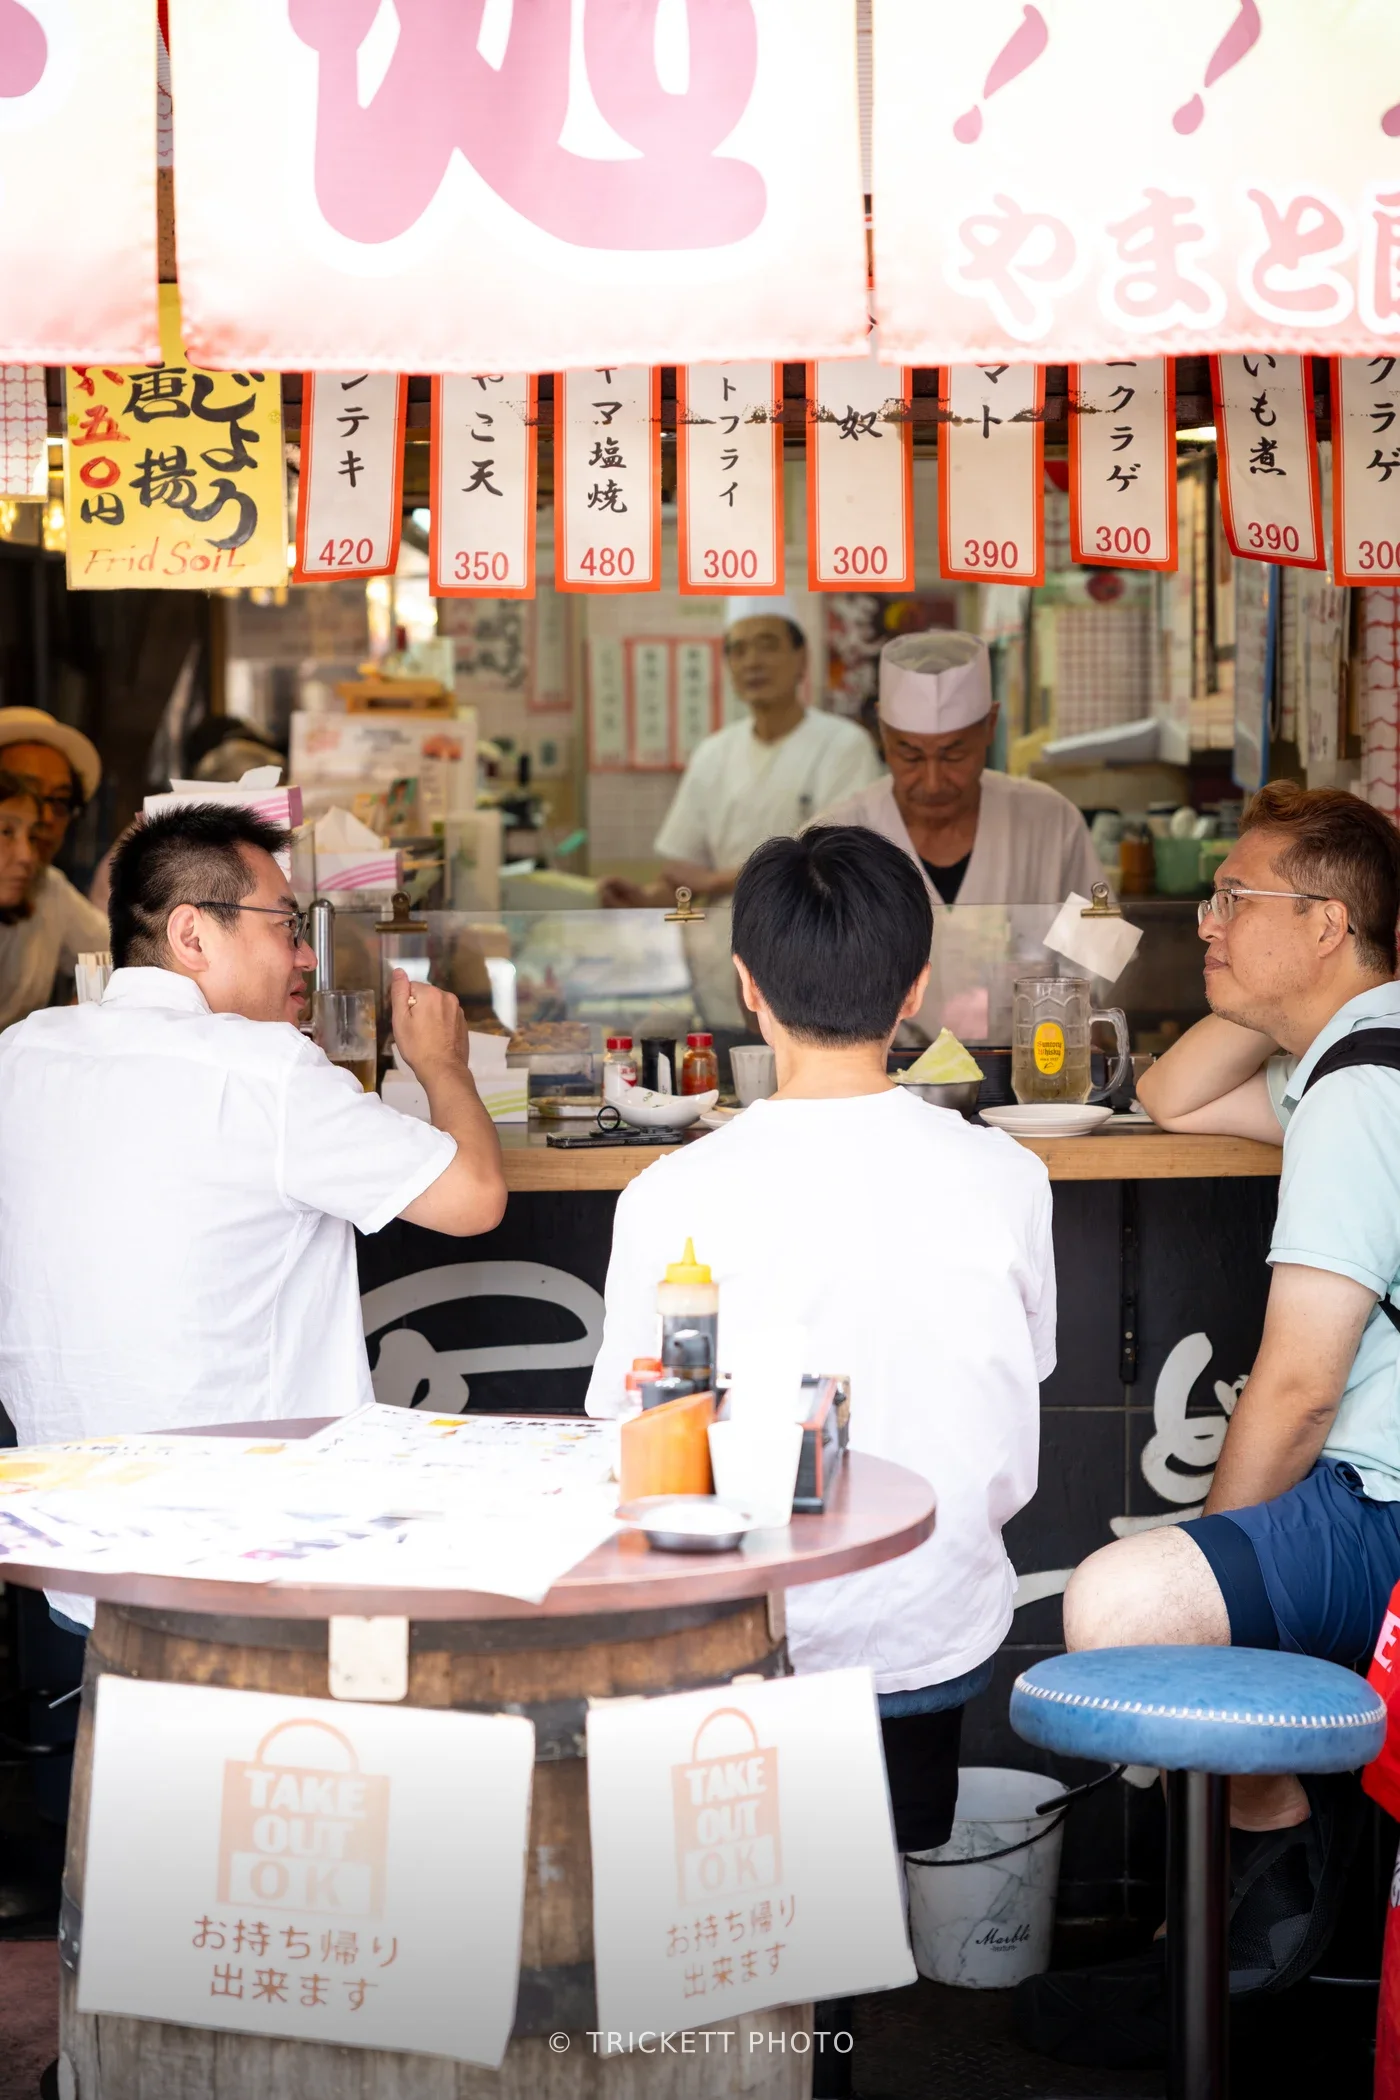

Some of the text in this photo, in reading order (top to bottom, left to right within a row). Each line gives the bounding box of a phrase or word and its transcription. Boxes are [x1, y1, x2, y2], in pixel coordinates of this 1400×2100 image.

[957, 186, 1400, 328] やまと
[835, 404, 883, 441] 奴
[1243, 353, 1287, 476] いも煮
[318, 537, 374, 567] 420
[832, 545, 889, 575] 300
[963, 538, 1019, 569] 390
[1095, 525, 1152, 555] 300
[1247, 521, 1300, 553] 390
[1358, 540, 1400, 570] 30
[454, 551, 510, 582] 350
[579, 546, 636, 577] 480
[703, 549, 758, 579] 300
[244, 1768, 366, 1819] TAKE
[685, 1756, 767, 1806] TAKE
[252, 1814, 356, 1860] OUT
[697, 1800, 760, 1846] OUT
[249, 1859, 343, 1908] OK
[699, 1844, 760, 1891] OK
[192, 1914, 398, 1968] お持ち帰り
[666, 1894, 796, 1958] お持ち帰り
[975, 1923, 1031, 1946] Marble
[210, 1962, 379, 2012] 出来ます
[683, 1941, 787, 1999] 出来ます
